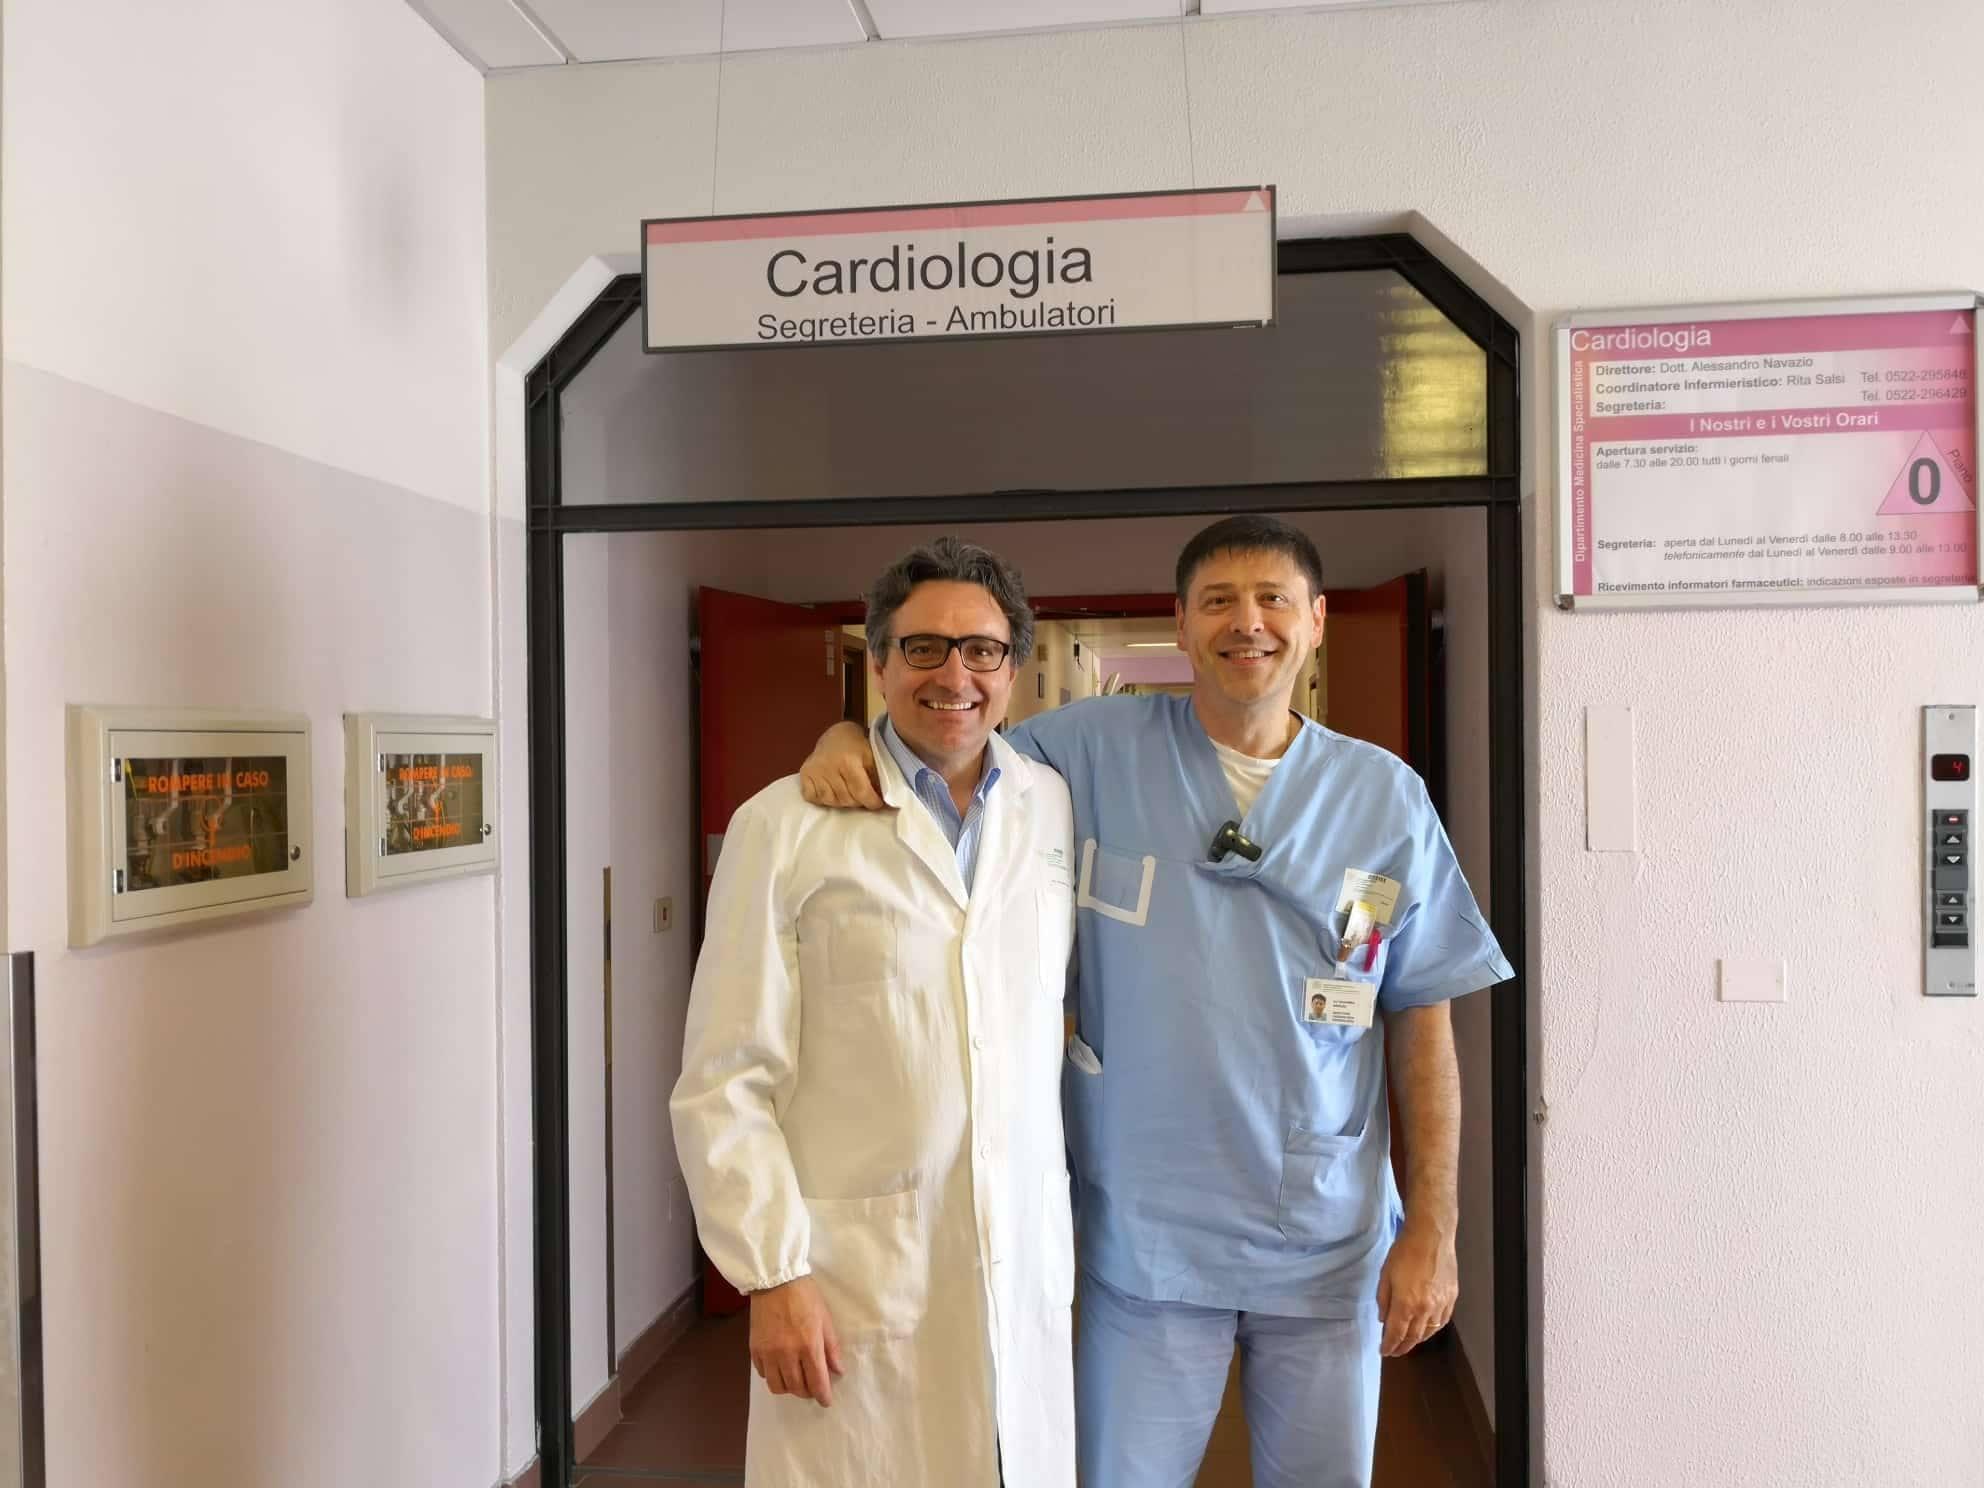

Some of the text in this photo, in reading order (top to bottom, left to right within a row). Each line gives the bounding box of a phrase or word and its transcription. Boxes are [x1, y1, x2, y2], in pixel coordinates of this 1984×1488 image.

[766, 236, 1093, 299] Cardiologia
[757, 306, 915, 342] Segreteria
[945, 298, 1116, 333] Ambulatori
[1571, 326, 1712, 352] Cardiologia
[1596, 356, 1813, 376] Direttore: Dott. Alessandro Navazio
[1596, 373, 1845, 394] Coordinatore Infermieristico: Rita Salsi
[1861, 371, 1881, 383] Tel.
[1861, 390, 1881, 402] Tel.
[1596, 400, 1665, 414] Segreteria:
[1690, 419, 1694, 431] I
[1700, 416, 1750, 431] Nostri
[1756, 418, 1766, 429] e
[1781, 414, 1830, 429] Vostri
[1836, 411, 1879, 426] Orari
[1596, 444, 1698, 458] Apertura servizio:
[1596, 458, 1621, 469] dalle
[1649, 457, 1667, 467] alle
[1670, 456, 1699, 467] 20.00
[1702, 455, 1721, 465] tutti
[1908, 457, 1941, 505] 0
[1598, 539, 1656, 551] Segreteria:
[1664, 536, 1696, 548] aperta
[1812, 533, 1836, 544] dalle
[1664, 549, 1745, 561] telefonicamente
[1598, 581, 1664, 592] Ricevimento
[1668, 579, 1728, 590] informatori
[149, 773, 213, 793] ROMPERE
[236, 771, 269, 788] CASO
